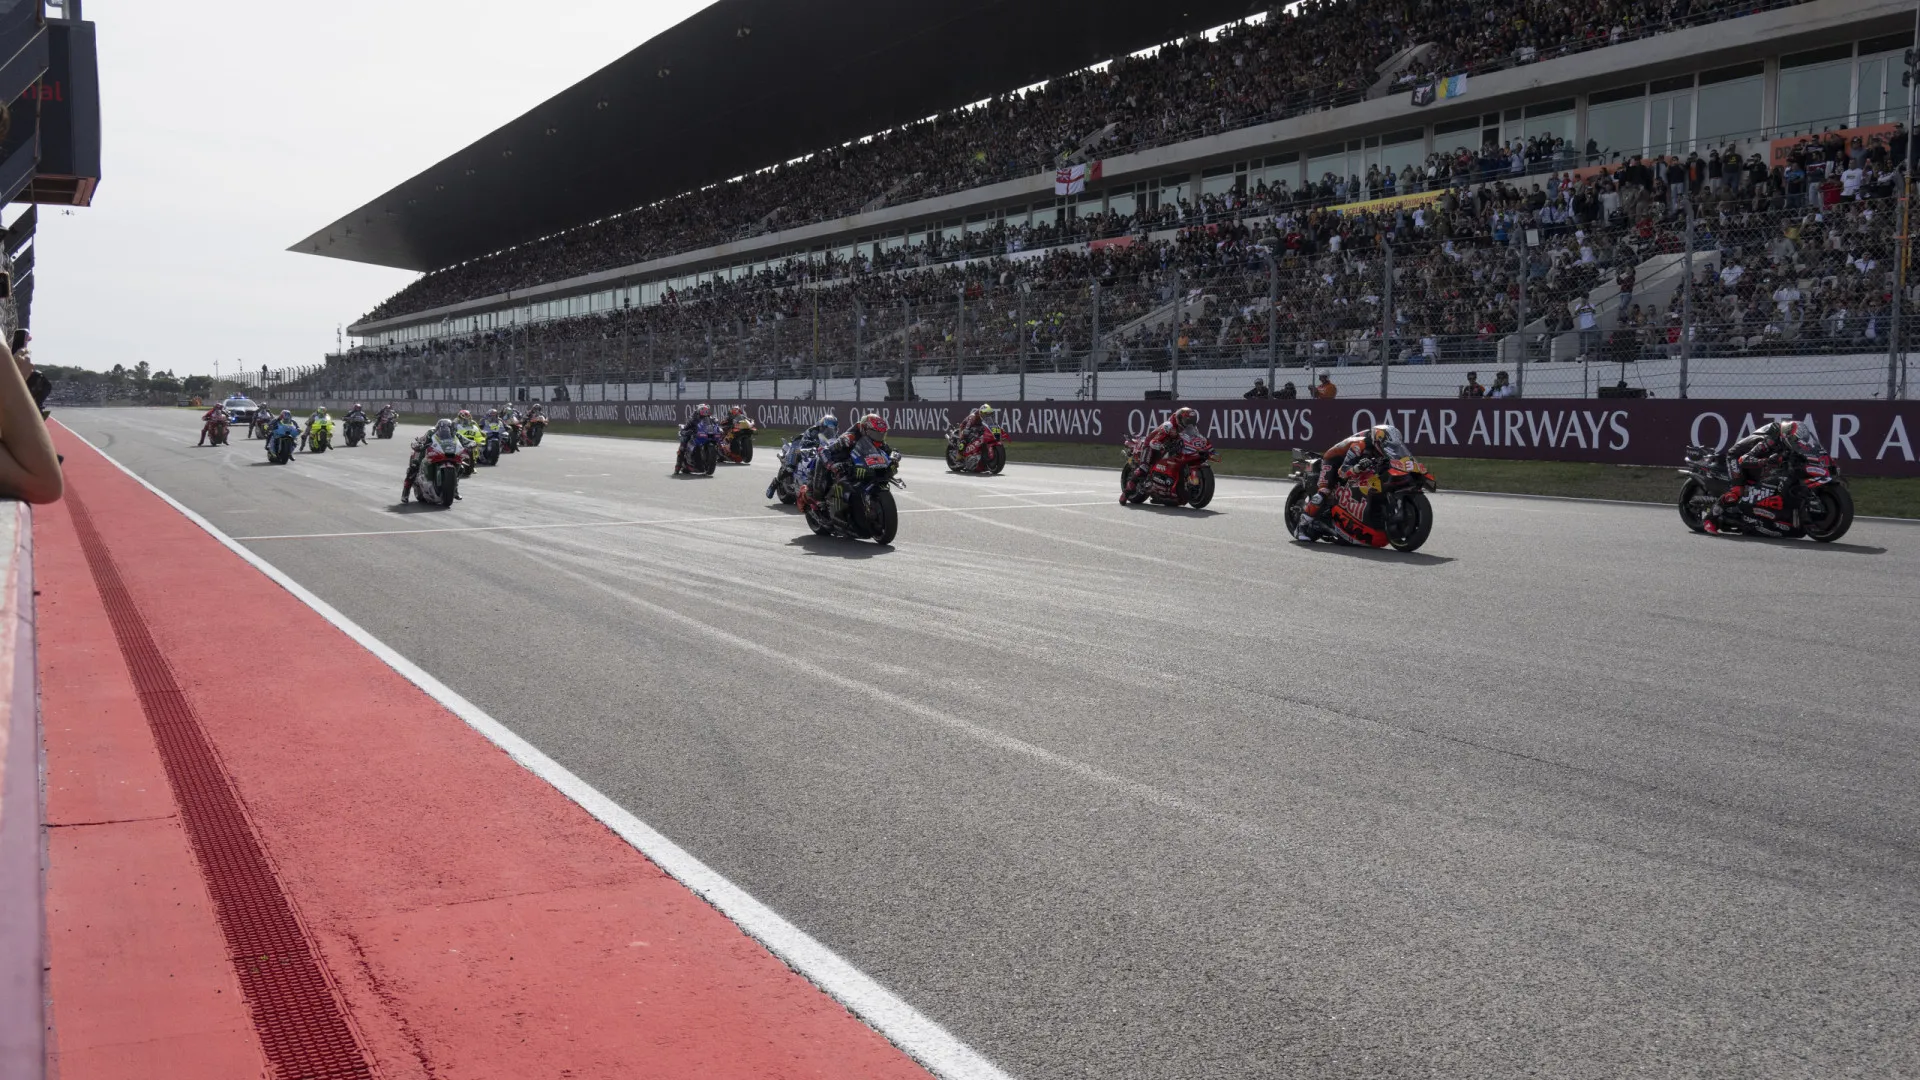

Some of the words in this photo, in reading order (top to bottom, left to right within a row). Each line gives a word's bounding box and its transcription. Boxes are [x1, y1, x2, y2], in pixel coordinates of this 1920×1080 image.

[625, 405, 647, 424] QATAR
[648, 405, 677, 422] AIRWAYS
[758, 405, 790, 428] QATAR
[850, 407, 891, 430] QAR
[893, 408, 950, 432] AIRWAYS
[1026, 408, 1102, 436] AIRWAYS
[1207, 408, 1314, 441] AIRWAYS
[1468, 410, 1630, 451] AIRWAYS
[1876, 414, 1920, 462] A
[1335, 484, 1368, 522] Bull
[1334, 511, 1373, 545] KTM
